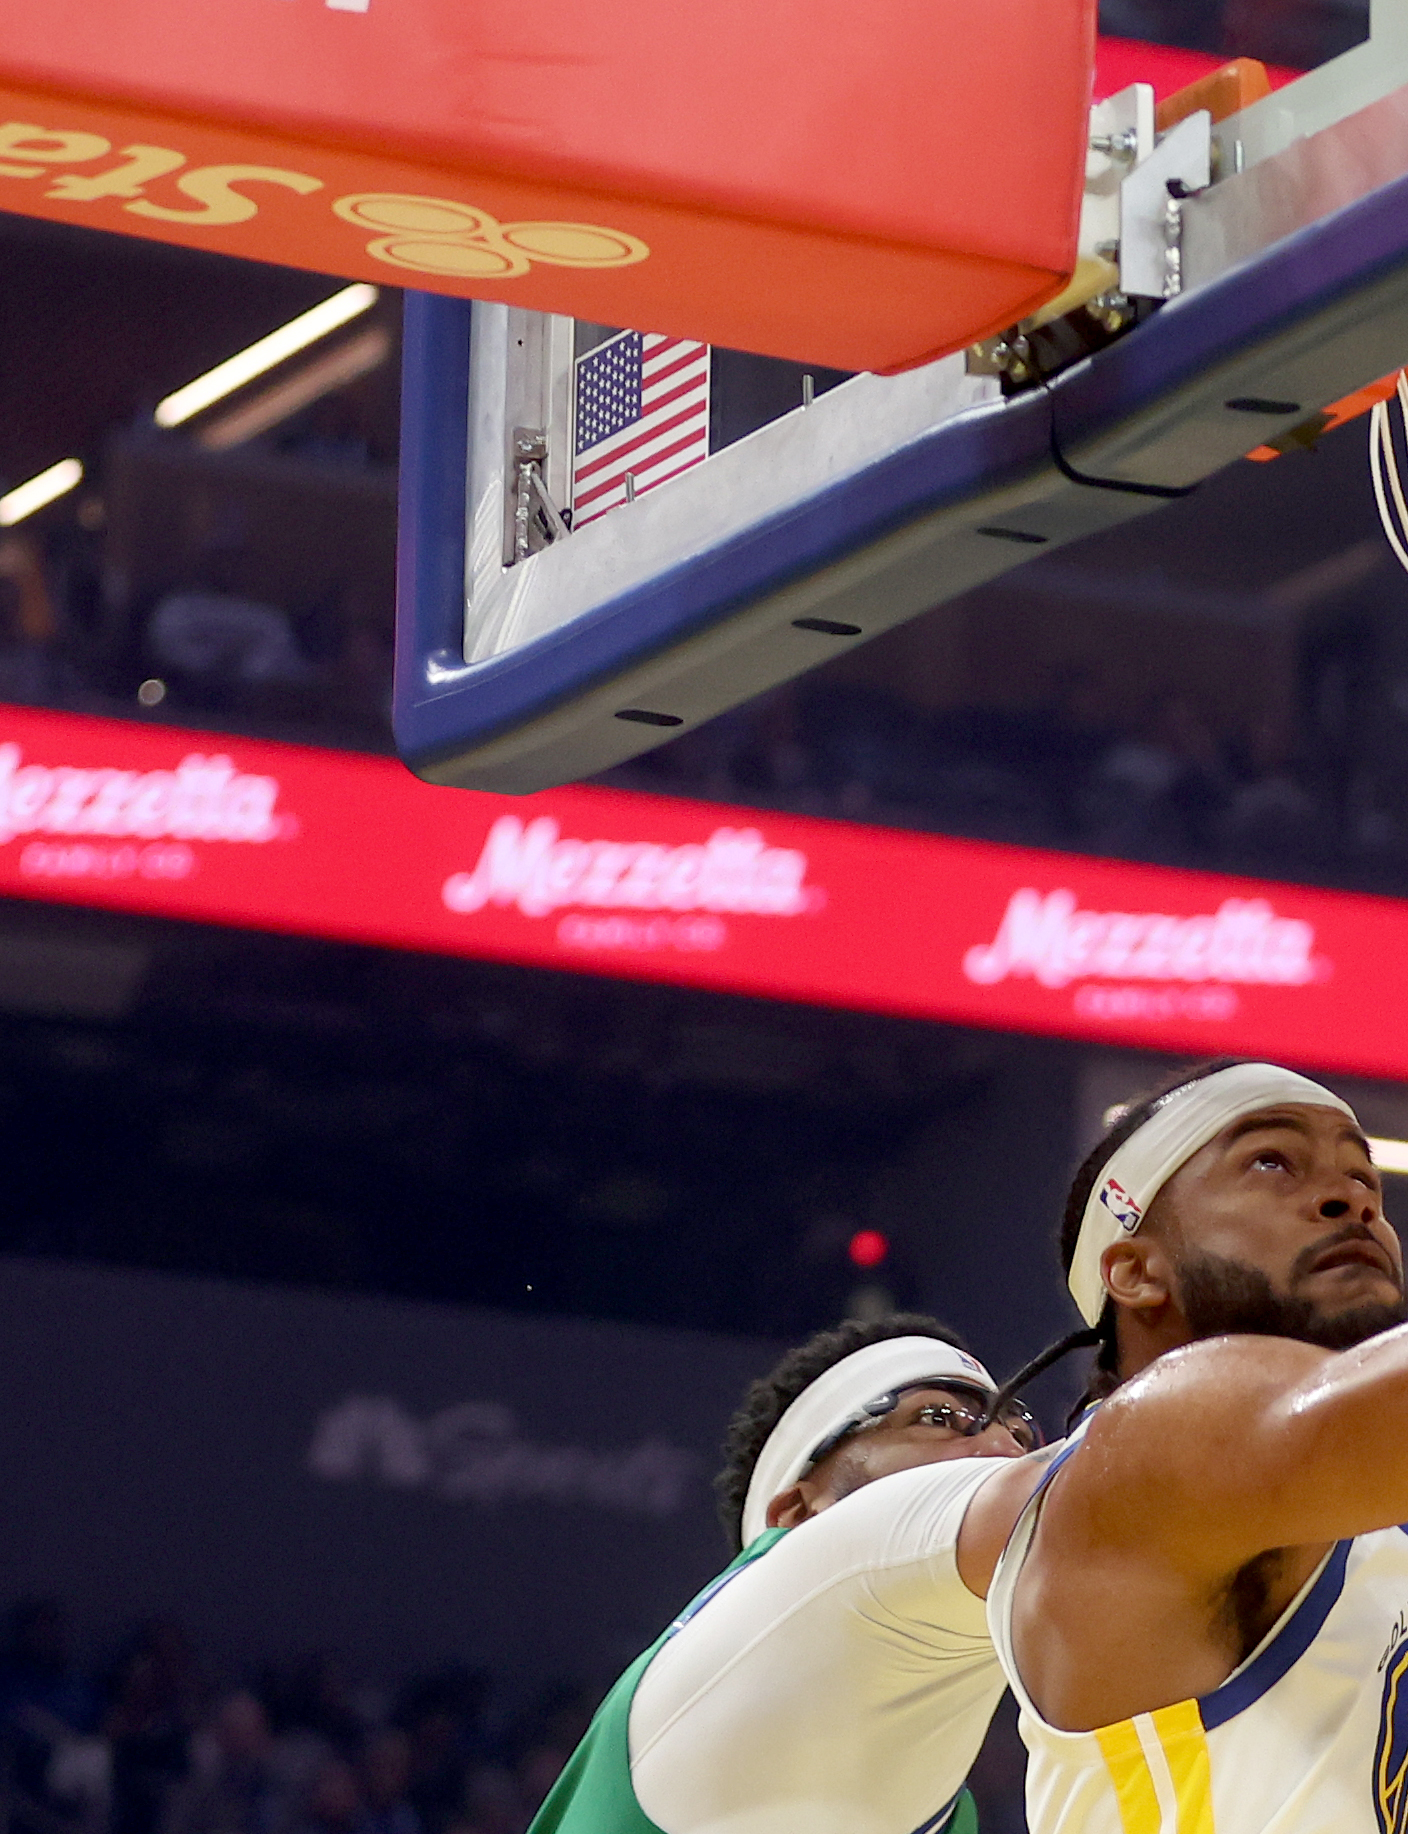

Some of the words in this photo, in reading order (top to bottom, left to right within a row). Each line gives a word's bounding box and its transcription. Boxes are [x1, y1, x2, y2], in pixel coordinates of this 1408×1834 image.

[0, 744, 280, 843] ezzetta
[444, 816, 806, 916] Mezzetta
[965, 890, 1315, 987] Mezzetta
